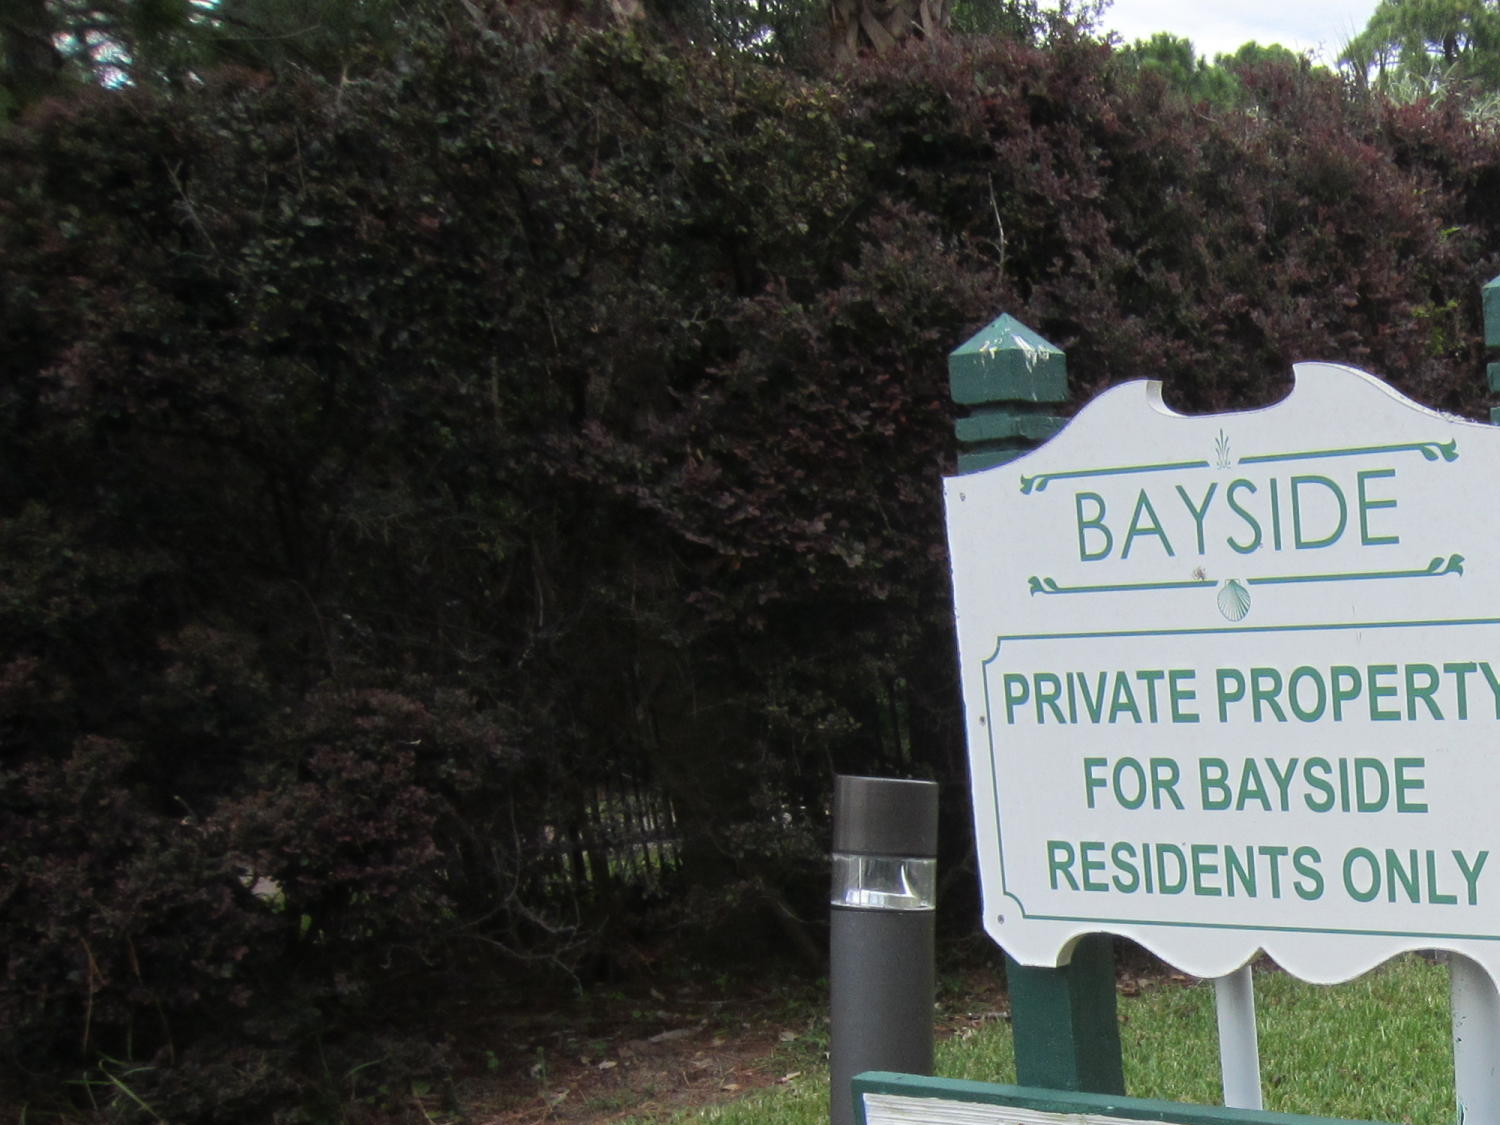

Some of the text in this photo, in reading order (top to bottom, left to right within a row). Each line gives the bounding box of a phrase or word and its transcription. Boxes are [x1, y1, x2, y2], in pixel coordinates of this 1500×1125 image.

[1076, 469, 1399, 562] BAYSIDE
[1004, 668, 1200, 724] PRIVATE
[1084, 757, 1429, 813] FOR BAYSIDE
[1047, 840, 1488, 906] RESIDENTS ONLY
